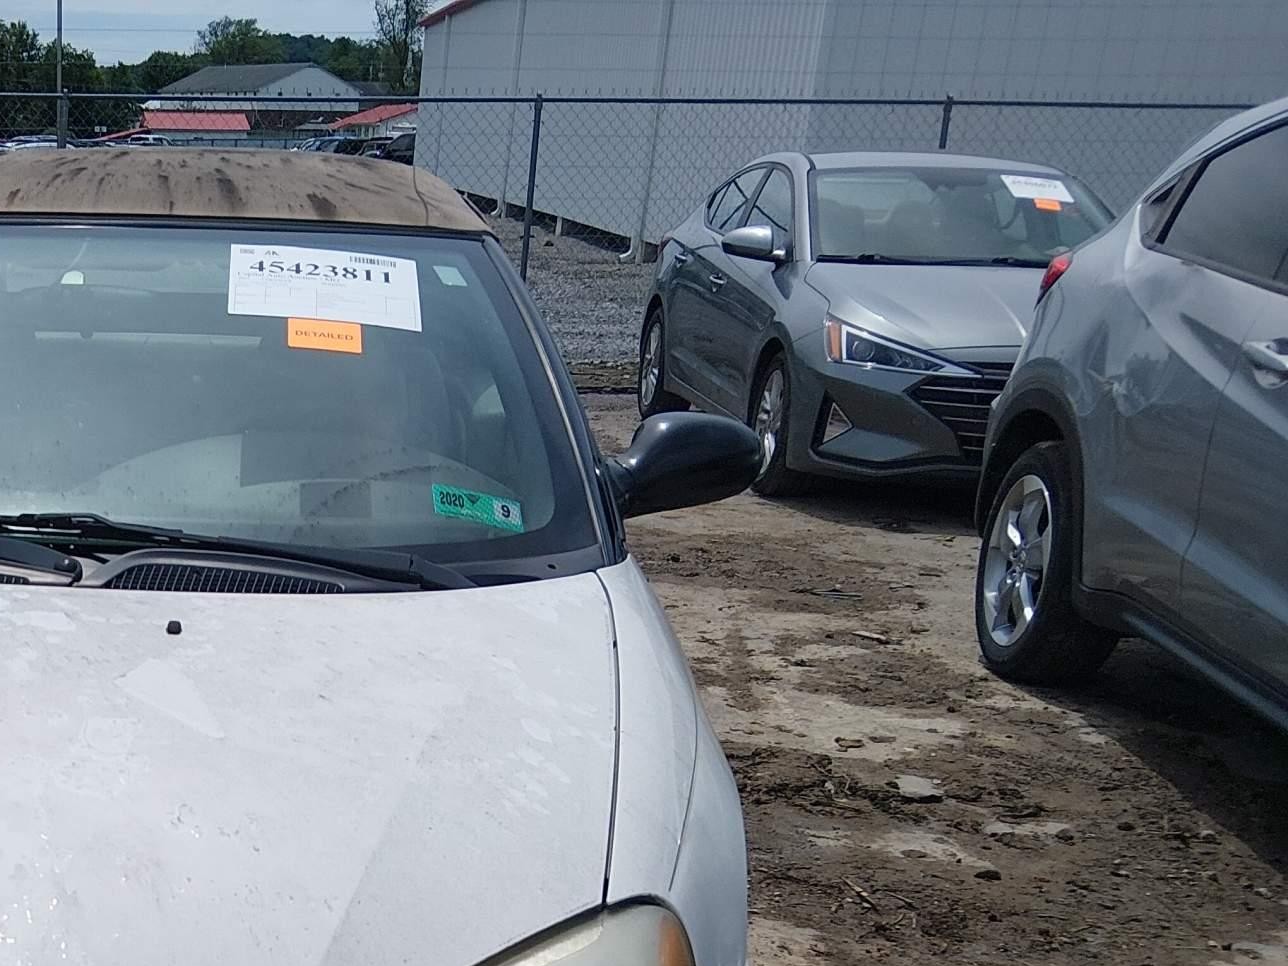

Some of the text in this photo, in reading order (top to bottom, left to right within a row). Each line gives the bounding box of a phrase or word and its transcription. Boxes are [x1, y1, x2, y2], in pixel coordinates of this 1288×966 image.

[249, 260, 392, 284] 45423811
[295, 329, 354, 341] DETAILED
[439, 491, 465, 509] 2020
[501, 504, 511, 518] 9
